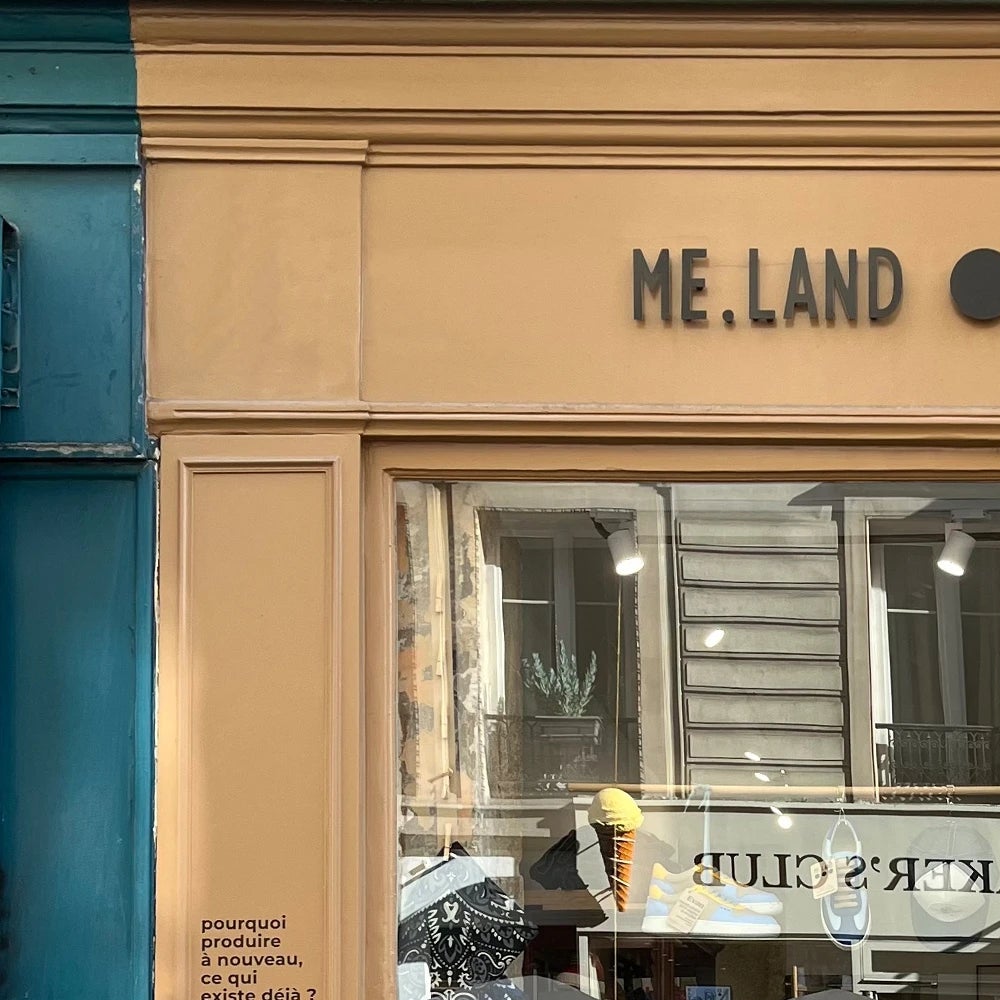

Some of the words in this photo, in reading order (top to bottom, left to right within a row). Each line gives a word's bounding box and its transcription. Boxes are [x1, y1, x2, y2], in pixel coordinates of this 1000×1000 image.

[632, 247, 903, 323] ME.LAND
[201, 915, 287, 933] pourquoi
[201, 934, 281, 951] produire
[201, 953, 211, 967] à
[218, 954, 303, 968] nouveau,
[201, 973, 222, 985] ce
[228, 970, 257, 987] qui
